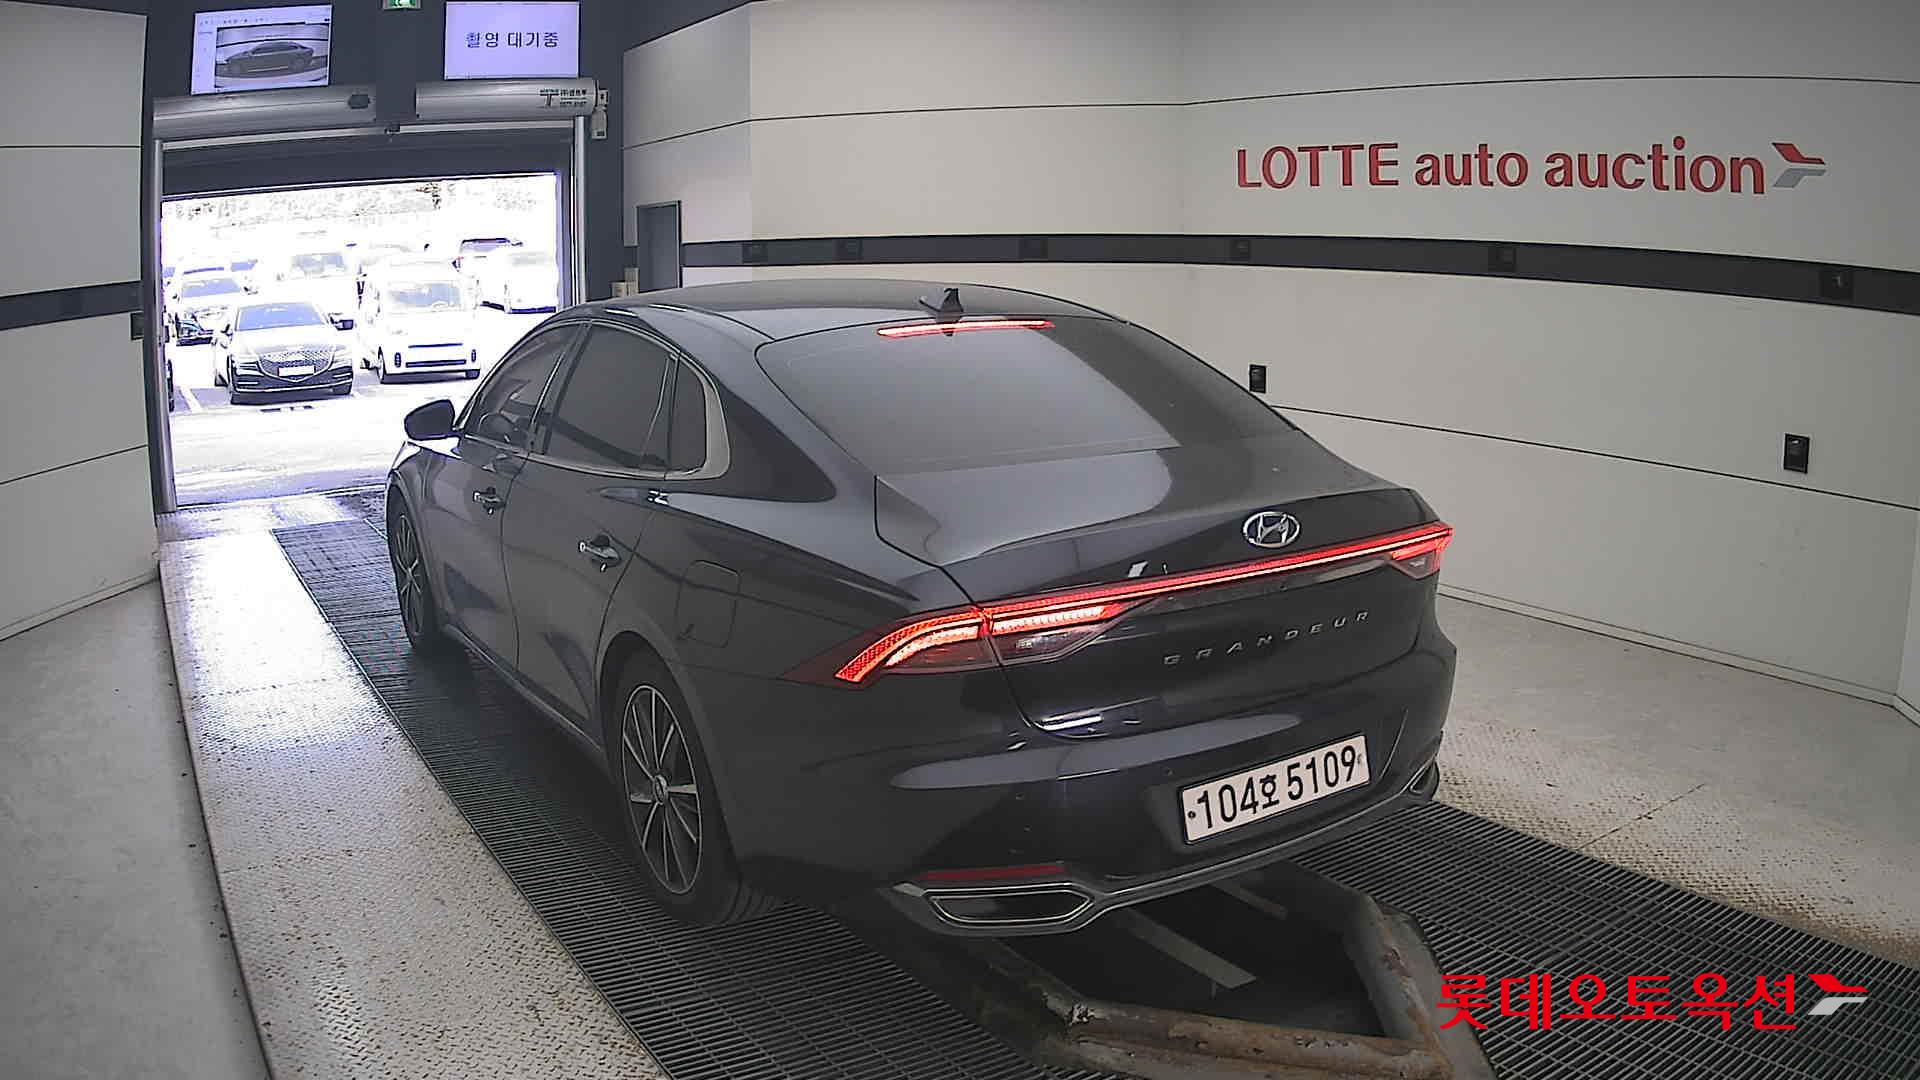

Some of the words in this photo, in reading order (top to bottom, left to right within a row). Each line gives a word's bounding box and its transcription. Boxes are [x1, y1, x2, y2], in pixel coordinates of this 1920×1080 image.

[507, 31, 559, 48] 대기중
[1237, 143, 1399, 189] LOTTE
[1415, 143, 1529, 187] auto
[1544, 136, 1765, 194] auction
[1163, 610, 1369, 665] GRANDEUR
[1197, 774, 1280, 828] 104호
[1286, 745, 1356, 801] 5109
